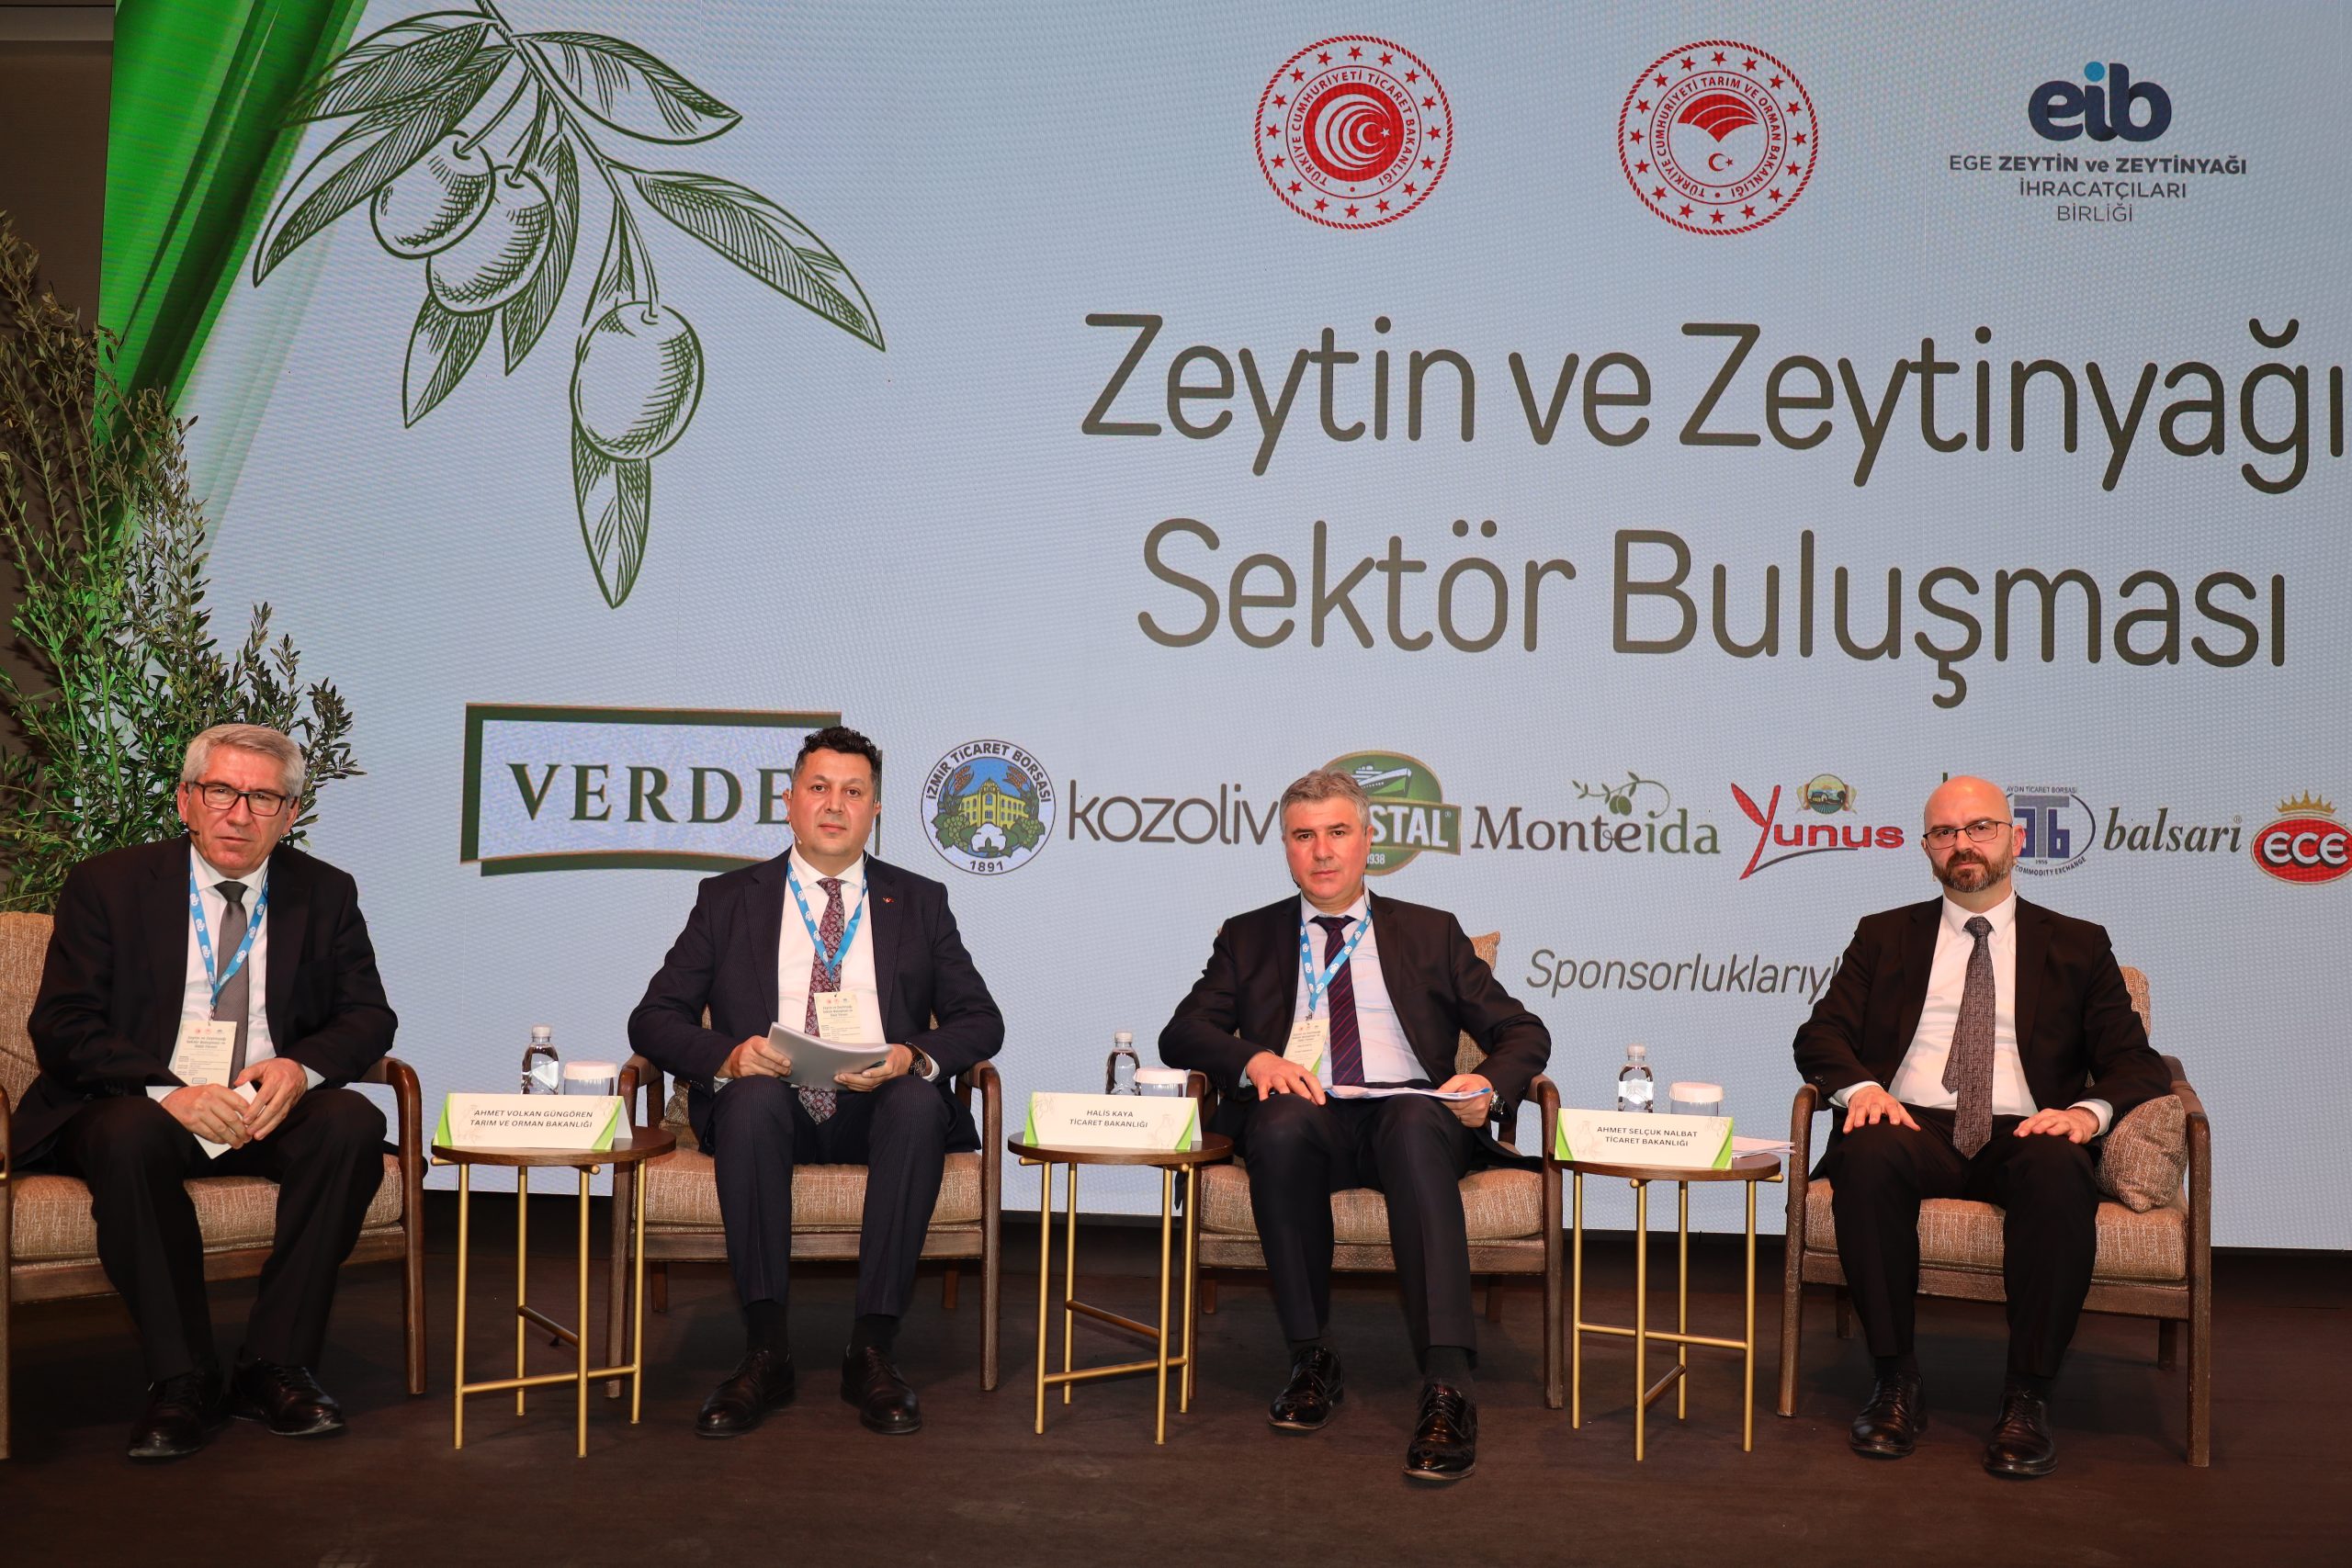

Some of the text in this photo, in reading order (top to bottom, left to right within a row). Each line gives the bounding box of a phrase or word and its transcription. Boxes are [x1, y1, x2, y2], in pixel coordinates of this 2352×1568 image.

[2029, 62, 2172, 141] eib
[1292, 70, 1417, 186] TÜRKİYE CUMHURİYETİ TİCARET BAKANLIĞI
[1655, 76, 1781, 197] TÜRKİYE CUMHURİYETİ TARIM VE ORMAN BAKANLIĞI
[1950, 153, 2247, 175] EGE ZEYTİN ve ZEYTİNYAĞI
[2019, 177, 2187, 200] İHRACATÇILARI
[2057, 202, 2133, 222] BİRLİĞİ
[1081, 313, 2345, 494] Zeytin ve Zeytinyağı
[1137, 517, 2285, 708] Sektör Buluşması
[1012, 750, 1052, 803] BORSASI
[1471, 806, 1720, 854] Monteida
[1731, 783, 1905, 880] Yunus
[969, 860, 1003, 873] 1891
[2054, 856, 2086, 874] EXCHANGE
[544, 1110, 594, 1118] GÜNGÖREN
[546, 1120, 593, 1128] BAKANLIĞI
[1069, 1118, 1148, 1128] TİCARET BAKANLIĞI
[1087, 1109, 1111, 1117] HALİS
[1605, 1135, 1689, 1147] TİCARET BAKANLIĞI
[1629, 1128, 1661, 1137] SELÇUK
[1664, 1130, 1698, 1138] NALBAT
